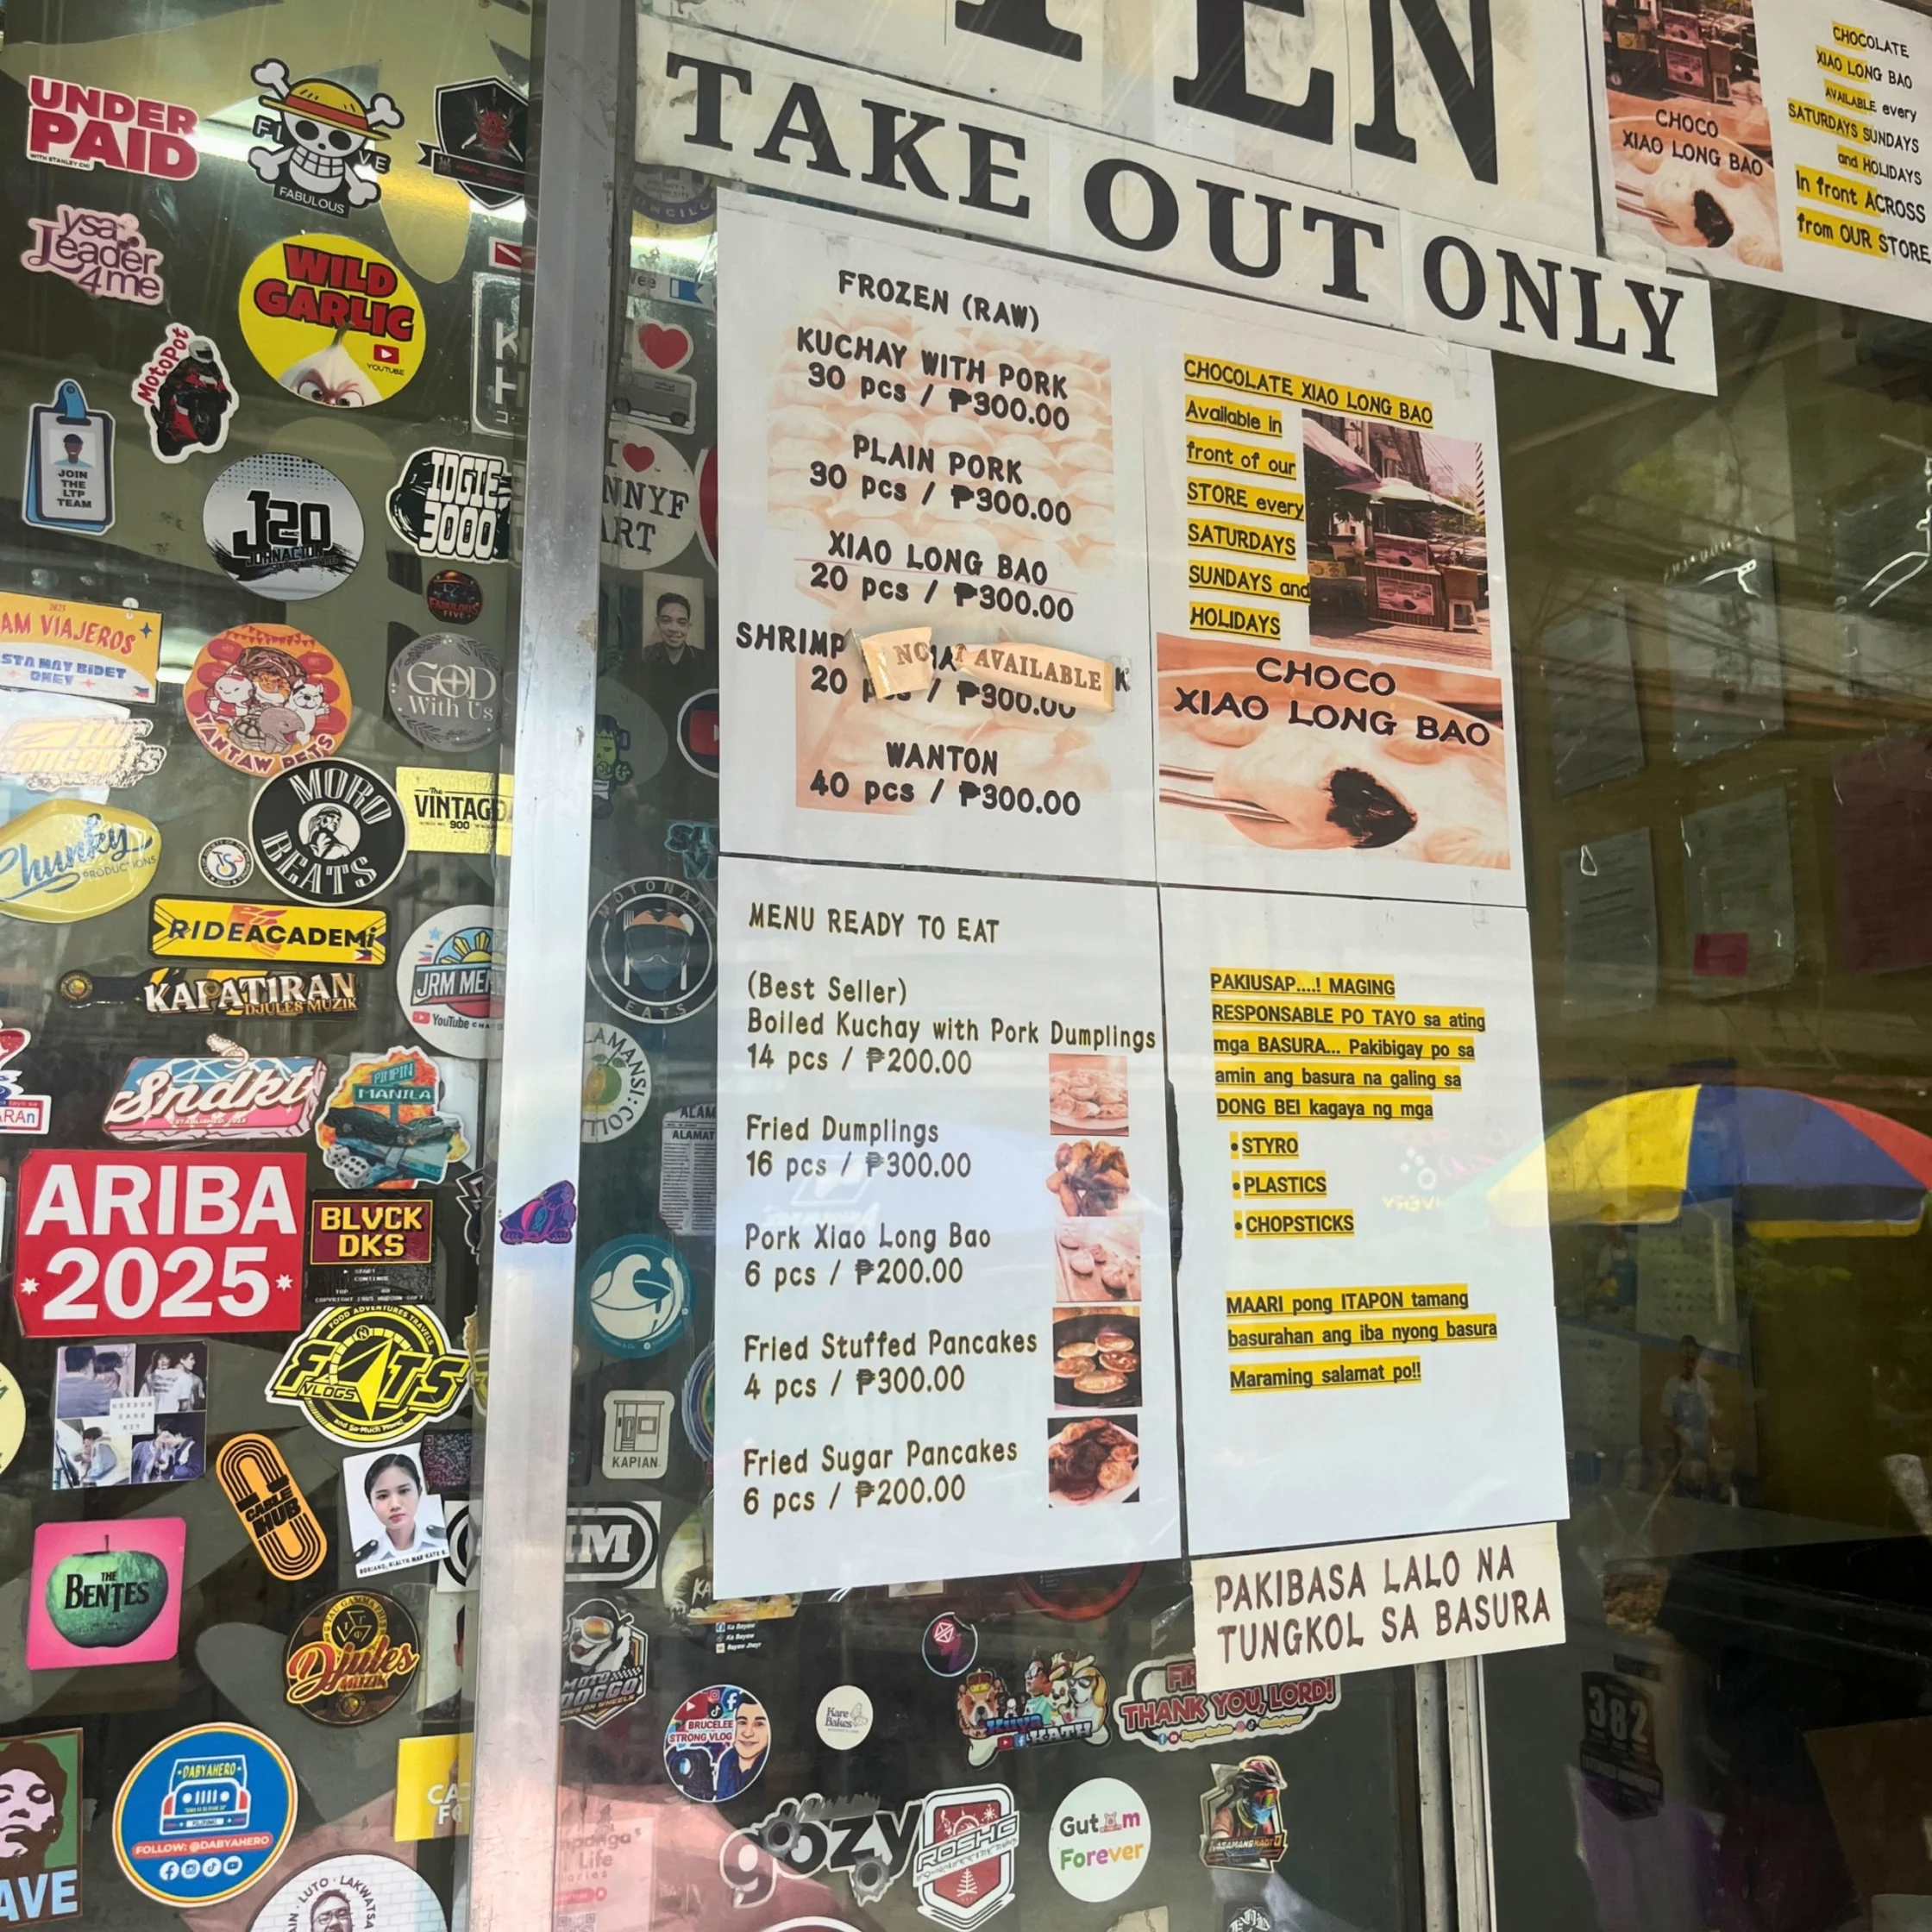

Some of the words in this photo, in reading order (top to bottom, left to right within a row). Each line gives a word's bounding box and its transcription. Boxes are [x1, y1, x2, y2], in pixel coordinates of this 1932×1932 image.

[1833, 26, 1910, 58] CHOCOLATE
[1816, 49, 1842, 72] XIAO
[1847, 58, 1883, 82] LONG
[1888, 69, 1913, 90] BAO
[30, 78, 198, 134] UNDER
[1825, 86, 1877, 112] AVAILABLE
[1882, 104, 1916, 122] every
[1655, 109, 1719, 138] CHOCO
[1788, 104, 1858, 138] SATURDAYS
[1863, 128, 1919, 154] SUNDAYS
[30, 109, 198, 180] PAID
[1622, 129, 1664, 155] XIAO
[1672, 142, 1721, 166] LONG
[1728, 154, 1764, 177] BAO
[1837, 151, 1858, 168] and
[1862, 157, 1923, 185] HOLIDAYS
[279, 185, 345, 215] FABULOUS
[666, 52, 1031, 219] TAKE
[1083, 159, 1384, 302] OUT
[1423, 235, 1684, 366] ONLY
[1796, 170, 1810, 192] In
[1865, 191, 1926, 224] ACROSS
[59, 210, 117, 240] ysa
[1797, 214, 1834, 240] from
[1841, 225, 1872, 249] OUR
[1879, 235, 1931, 264] STORE
[283, 243, 398, 298] WILD
[254, 279, 415, 342] GARLIC
[838, 270, 949, 315] FROZEN
[962, 293, 1039, 333] (RAW)
[137, 327, 191, 405] MotoPot
[367, 362, 405, 376] YOUTUBE
[797, 327, 907, 369] KUCHAY
[921, 350, 985, 383] WITH
[999, 363, 1068, 399] PORK
[58, 469, 88, 480] JOIN
[853, 435, 935, 474] PLAIN
[949, 451, 1023, 486] PORK
[61, 480, 86, 489] THE
[63, 489, 85, 498] LTP
[56, 499, 92, 509] TEAM
[232, 490, 331, 557] J20
[419, 500, 498, 559] 3000
[442, 610, 465, 618] FIVE
[41, 614, 136, 655] VIAJEROS
[737, 622, 845, 658] SHRIMP
[77, 662, 127, 679] BIDET
[407, 661, 498, 701] GOD
[973, 649, 1102, 691] AVAILABLE
[1256, 656, 1396, 697] CHOCO
[409, 695, 459, 718] With
[468, 701, 494, 721] Us
[1173, 687, 1269, 721] XIAO
[1288, 699, 1397, 737] LONG
[1415, 715, 1490, 748] BAO
[194, 712, 273, 774] YANTAW
[886, 741, 998, 776] WANTON
[288, 767, 393, 826] MORO
[450, 820, 470, 830] 900
[84, 855, 156, 880] PRODUCTIONS
[260, 831, 378, 896] BEATS
[748, 901, 815, 932] MENU
[827, 907, 905, 938] READY
[918, 915, 946, 941] TO
[957, 917, 1000, 944] EAT
[416, 971, 455, 998] JRM
[748, 969, 815, 1001] (Best
[827, 975, 907, 1007] Seller)
[1210, 973, 1320, 993] PAKIUSAP....!
[1329, 977, 1396, 995] MAGING
[307, 997, 358, 1013] MUZIK
[433, 1013, 469, 1029] YouTube
[624, 999, 687, 1019] EATS
[748, 1007, 824, 1035] Boiled
[837, 1010, 920, 1044] Kuchay
[932, 1018, 979, 1042] with
[991, 1018, 1039, 1044] Pork
[1051, 1020, 1156, 1053] Dumplings
[748, 1043, 775, 1070] 14
[787, 1049, 829, 1075] pcs
[842, 1046, 853, 1071] /
[358, 1088, 431, 1100] MANILA
[672, 1130, 715, 1140] ALAMAT
[1242, 1138, 1299, 1153] STYRO
[25, 1164, 298, 1236] ARIBA
[1244, 1176, 1327, 1194] PLASTICS
[321, 1207, 422, 1231] BLVCK
[1245, 1214, 1354, 1233] CHOPSTICKS
[338, 1234, 405, 1258] DKS
[42, 1247, 271, 1320] 2025
[328, 1310, 351, 1329] FOOD
[353, 1305, 409, 1320] ADVENTURES
[409, 1314, 435, 1346] TRAVELS
[303, 1382, 356, 1400] VLOGS
[1230, 1368, 1314, 1389] Maraming
[1321, 1364, 1385, 1384] salamat
[1393, 1362, 1421, 1384] po!!
[334, 1417, 348, 1428] and
[612, 1456, 658, 1468] KAPIAN
[245, 1485, 293, 1524] CABLE
[253, 1497, 302, 1540] HUB
[65, 1574, 150, 1612] BENTES
[101, 1571, 117, 1582] THE
[1214, 1560, 1366, 1613] PAKIBASA
[1383, 1552, 1460, 1594] LALO
[1477, 1544, 1515, 1583] NA
[324, 1604, 340, 1624] TAU
[341, 1596, 374, 1608] GAMMA
[1217, 1611, 1364, 1664] TUNGKOL
[1381, 1603, 1420, 1642] SA
[1434, 1587, 1551, 1637] BASURA
[562, 1671, 611, 1693] MOTO
[585, 1703, 597, 1711] ON
[598, 1694, 636, 1708] WHEELS
[826, 1707, 850, 1718] Kare
[1122, 1695, 1208, 1731] THANK
[1211, 1688, 1268, 1720] YOU,
[1269, 1676, 1334, 1712] LORD!
[1588, 1684, 1648, 1743] 382
[669, 1733, 707, 1742] STRONG
[709, 1732, 733, 1741] VLOG
[688, 1720, 733, 1730] BRUCELEE
[825, 1716, 853, 1728] Bakes
[182, 1762, 236, 1778] DABYAHERO
[135, 1842, 187, 1855] FOLLOW:
[189, 1835, 270, 1852] @DABYAHERO
[1060, 1841, 1145, 1871] Forever
[298, 1877, 329, 1904] LUTO
[339, 1875, 376, 1929] LAKWATSA
